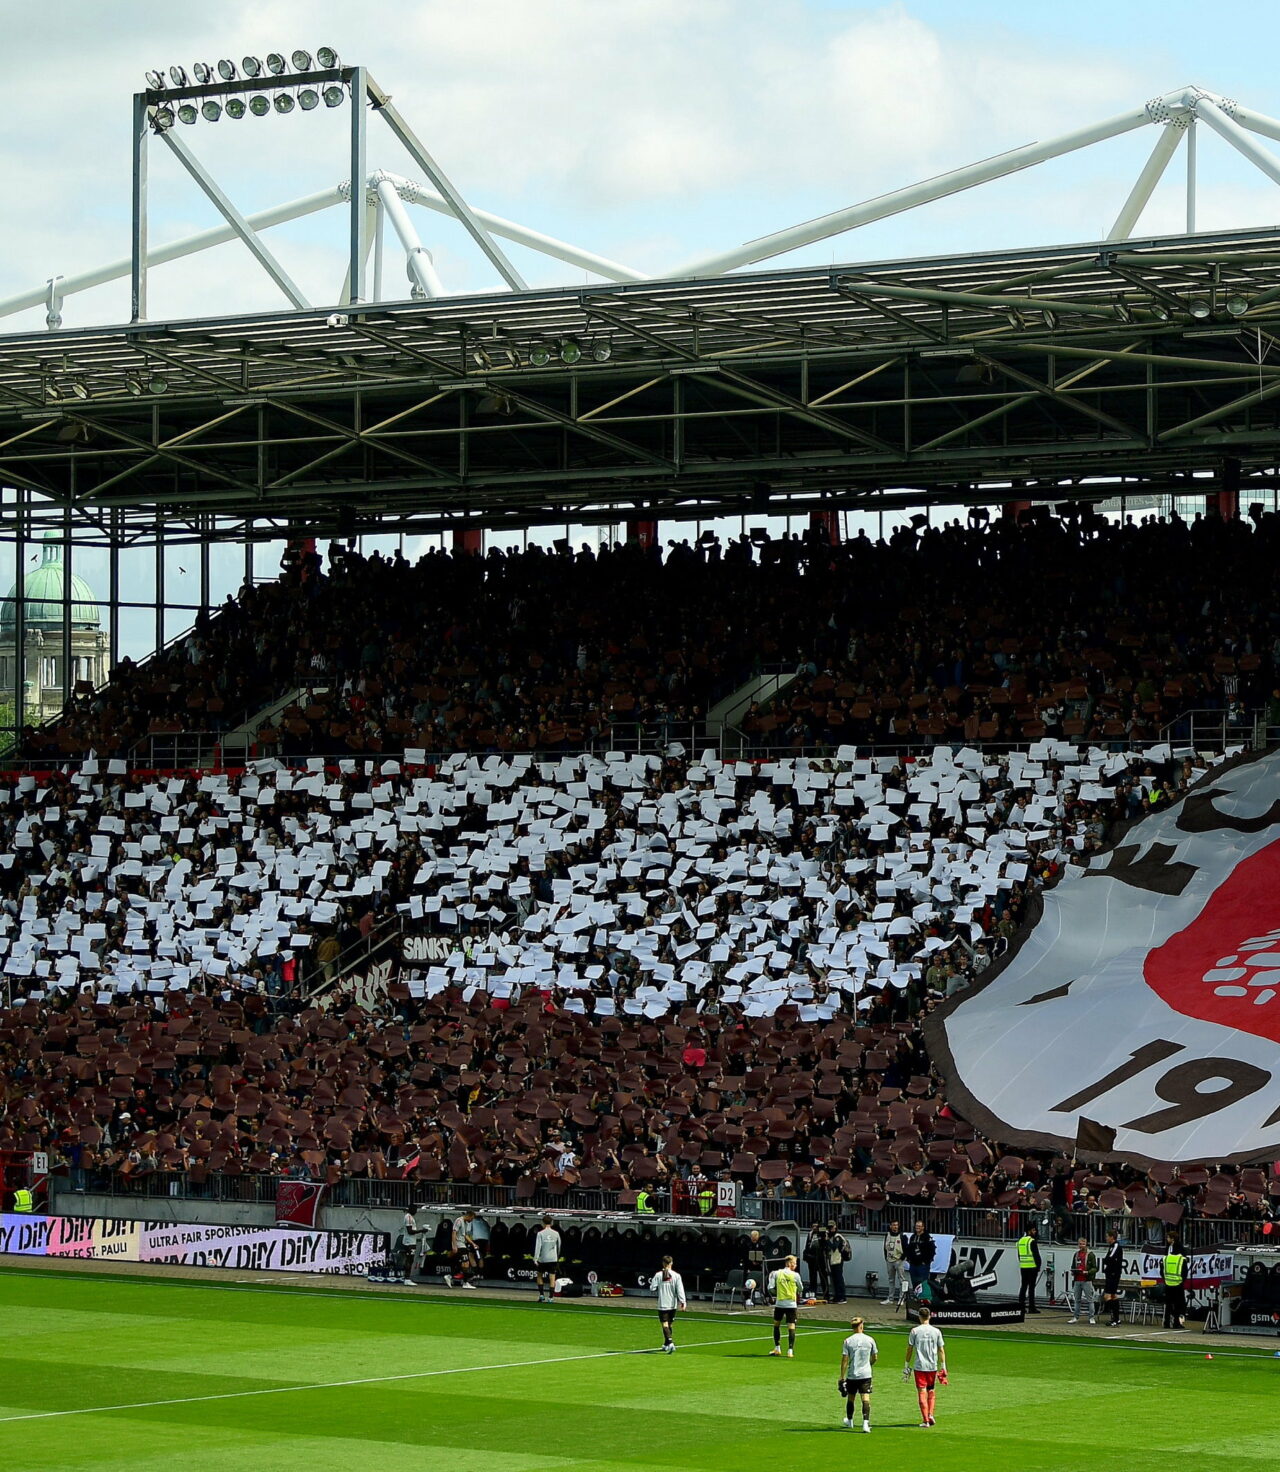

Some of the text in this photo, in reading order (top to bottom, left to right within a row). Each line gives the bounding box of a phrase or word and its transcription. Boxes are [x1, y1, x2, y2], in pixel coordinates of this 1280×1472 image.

[403, 936, 453, 961] SANKT
[37, 1156, 46, 1169] E1
[720, 1187, 733, 1201] D2
[149, 1226, 271, 1249] ULTRA FAIR SPORTSWEAR
[86, 1246, 99, 1257] ST.
[102, 1242, 127, 1256] PAULI
[436, 1265, 452, 1274] gsm
[517, 1269, 549, 1279] congsr
[1250, 1314, 1270, 1323] gsm
